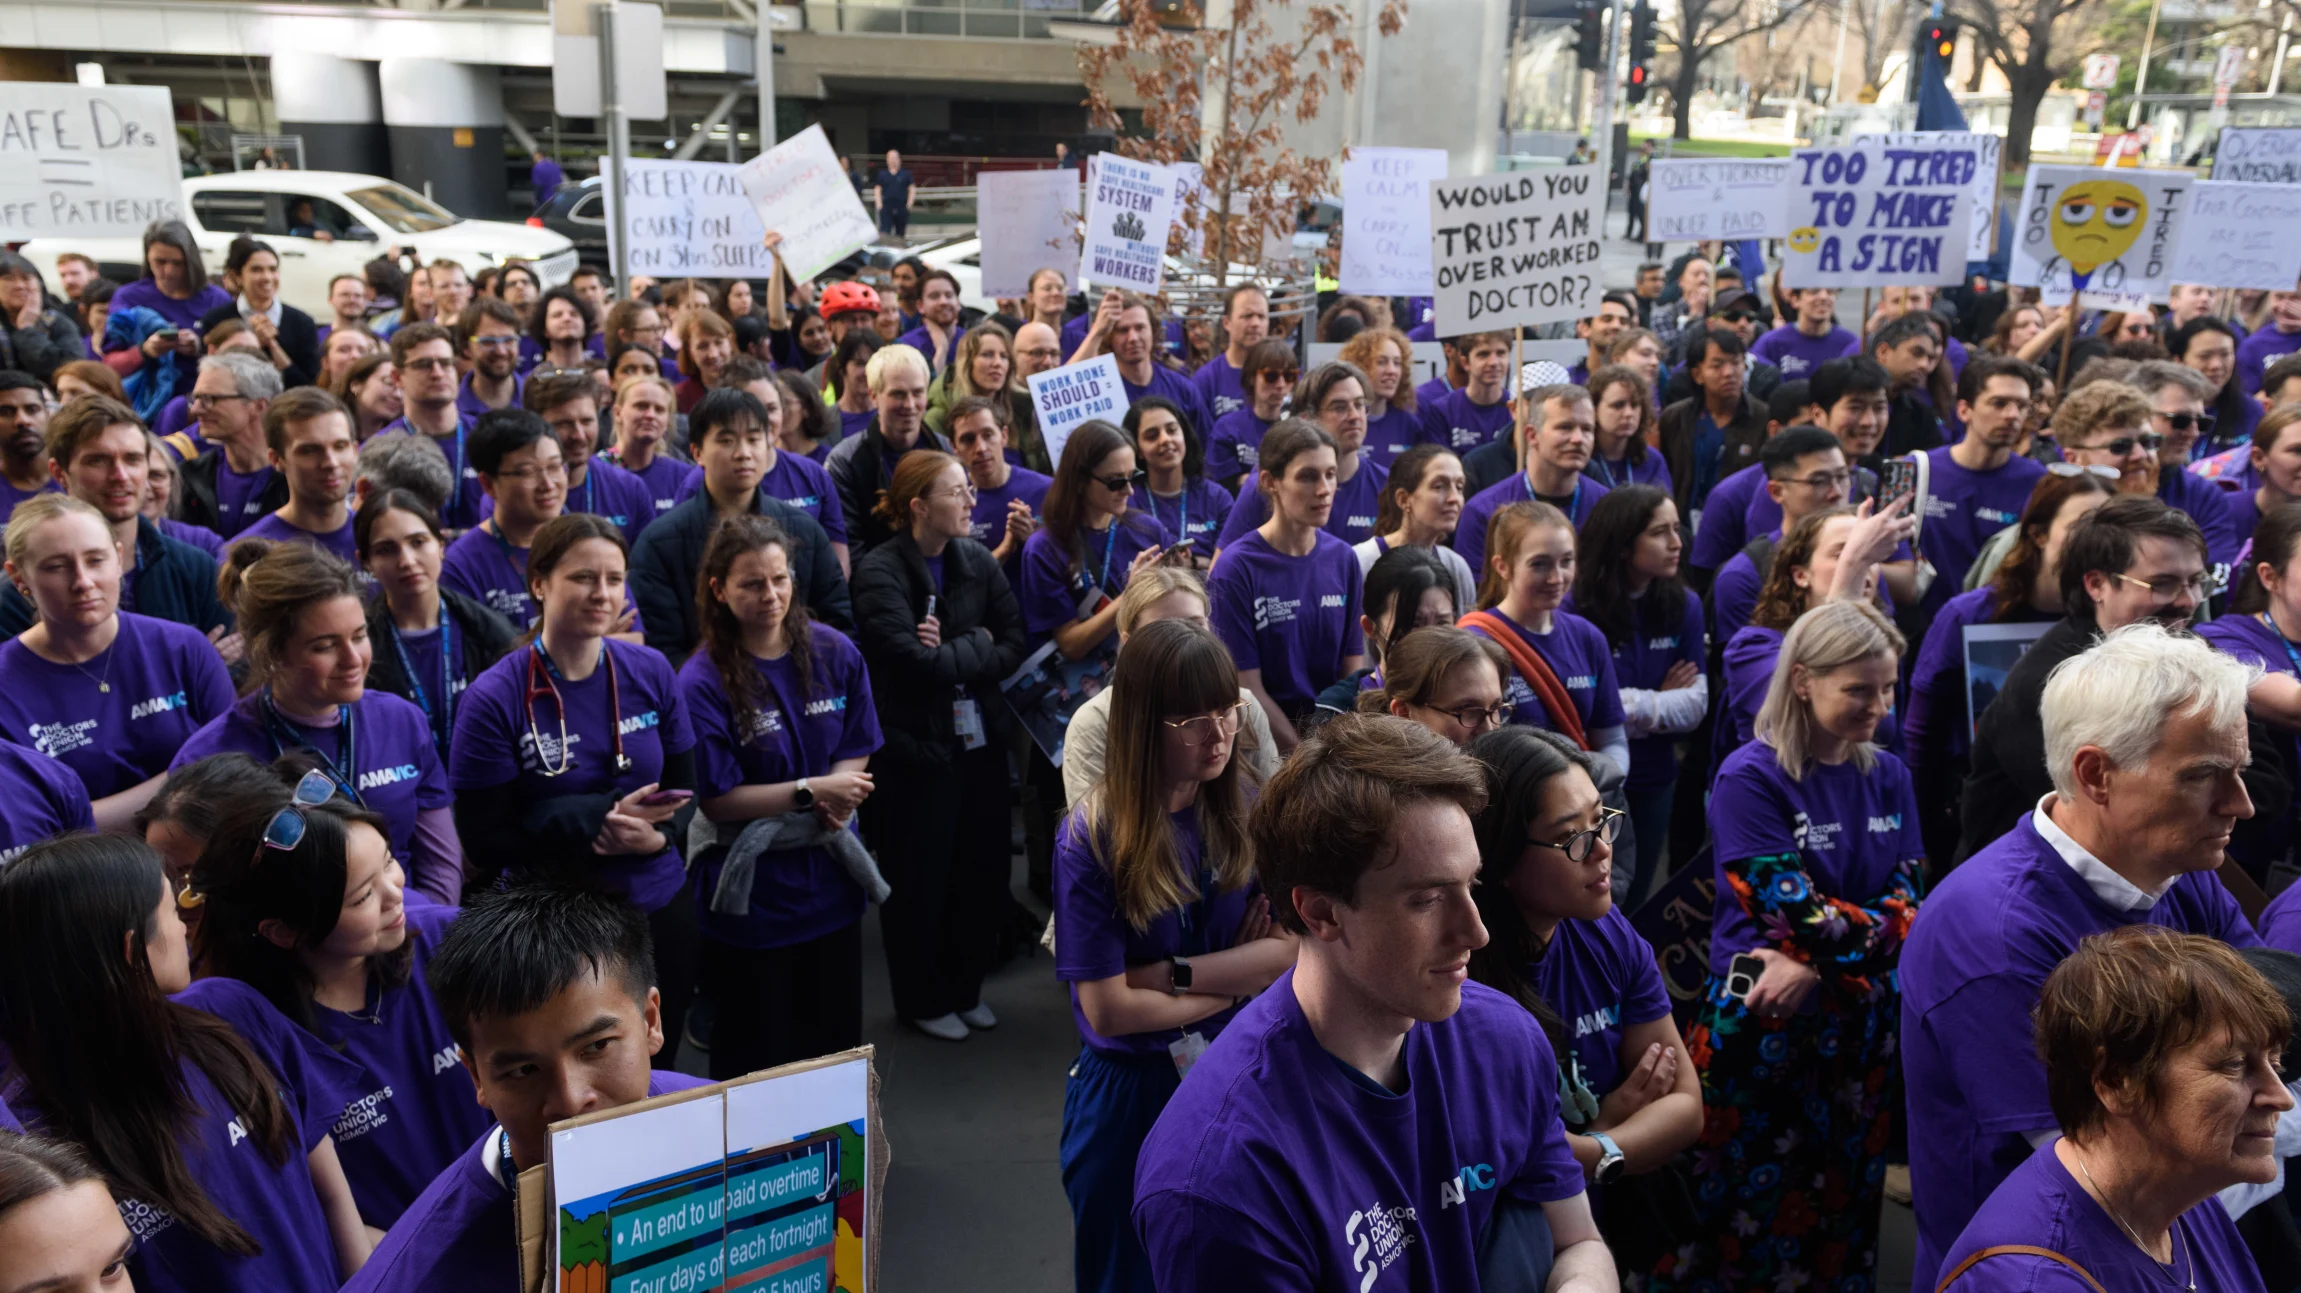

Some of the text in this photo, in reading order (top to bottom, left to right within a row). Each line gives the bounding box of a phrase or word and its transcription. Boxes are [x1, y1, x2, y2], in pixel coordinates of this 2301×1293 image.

[1, 109, 82, 151] AFE
[1102, 160, 1127, 176] THERE
[1129, 167, 1138, 179] IS
[1140, 170, 1152, 182] NO
[1371, 157, 1414, 178] KEEP
[1660, 164, 1712, 187] OVER
[1796, 152, 1868, 186] TOO
[1883, 149, 1977, 187] TIRED
[623, 168, 697, 198] KEEP
[1101, 173, 1166, 197] SAFE HEALTHCARE
[1365, 180, 1420, 199] CALM
[1437, 173, 1590, 211] WOULD YOU
[50, 190, 181, 226] PATIENTS
[1097, 184, 1154, 213] SYSTEM
[1811, 190, 1856, 228] TO
[1865, 190, 1958, 229] MAKE
[631, 215, 731, 241] CARRY ON
[1361, 215, 1410, 238] CARRY
[1437, 207, 1590, 258] TRUST AN
[1720, 210, 1766, 233] PAID
[629, 248, 661, 269] ON
[1095, 243, 1159, 266] SAFE HEALTHCARE
[1126, 241, 1161, 256] WITHOUT
[1817, 233, 1944, 274] A SIGN
[1094, 257, 1157, 284] WORKERS
[1437, 255, 1506, 289] OVER
[1511, 240, 1600, 275] WORKED
[1468, 274, 1592, 321] DOCTOR?
[1037, 364, 1106, 394] WORK DONE
[1040, 380, 1102, 411] SHOULD
[1047, 397, 1114, 426] WORK PAID
[1347, 515, 1377, 527] AMAV
[1267, 599, 1302, 611] DOCTORS
[1320, 593, 1348, 608] AMAV
[131, 690, 187, 720] AMAVIC
[42, 722, 63, 735] THE
[46, 718, 98, 744] DOCTORS
[612, 710, 659, 735] MAVIC
[49, 731, 85, 751] UNION
[359, 763, 419, 791] AMAVIC
[1808, 822, 1842, 835] CTORS
[1867, 813, 1902, 832] AMAV
[1575, 1003, 1620, 1039] AMAV
[339, 1086, 393, 1120] OCTORS
[333, 1106, 378, 1135] UNION
[339, 1113, 388, 1144] ASMOF VIC
[631, 1216, 654, 1247] An
[657, 1202, 687, 1238] end
[689, 1201, 705, 1227] to
[759, 1164, 820, 1201] overtime
[1365, 1201, 1384, 1228] THE
[131, 1205, 170, 1236] UNIO
[1370, 1206, 1418, 1244] DOCTOR
[669, 1262, 706, 1293] days
[709, 1246, 725, 1278] of
[729, 1233, 766, 1267] each
[769, 1212, 828, 1254] fortnight
[1375, 1220, 1406, 1258] UNION
[1381, 1233, 1417, 1272] ASMOF VIC
